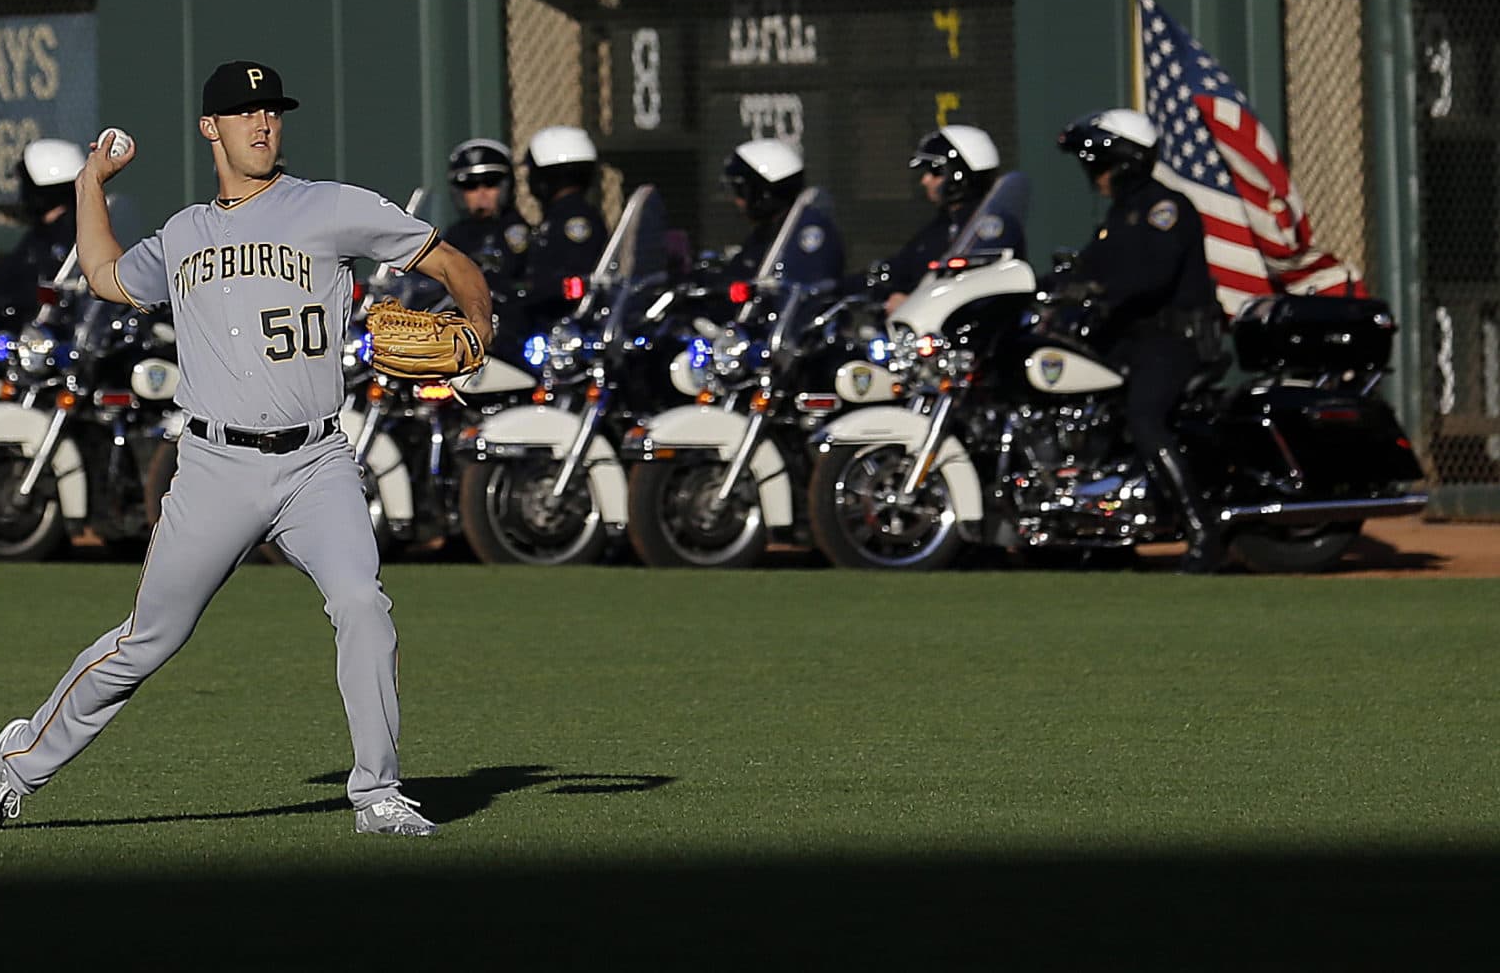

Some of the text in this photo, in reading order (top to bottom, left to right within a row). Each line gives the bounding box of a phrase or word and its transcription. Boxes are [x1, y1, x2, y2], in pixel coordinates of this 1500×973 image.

[247, 68, 263, 89] P
[631, 27, 661, 130] 8
[260, 303, 329, 363] 50
